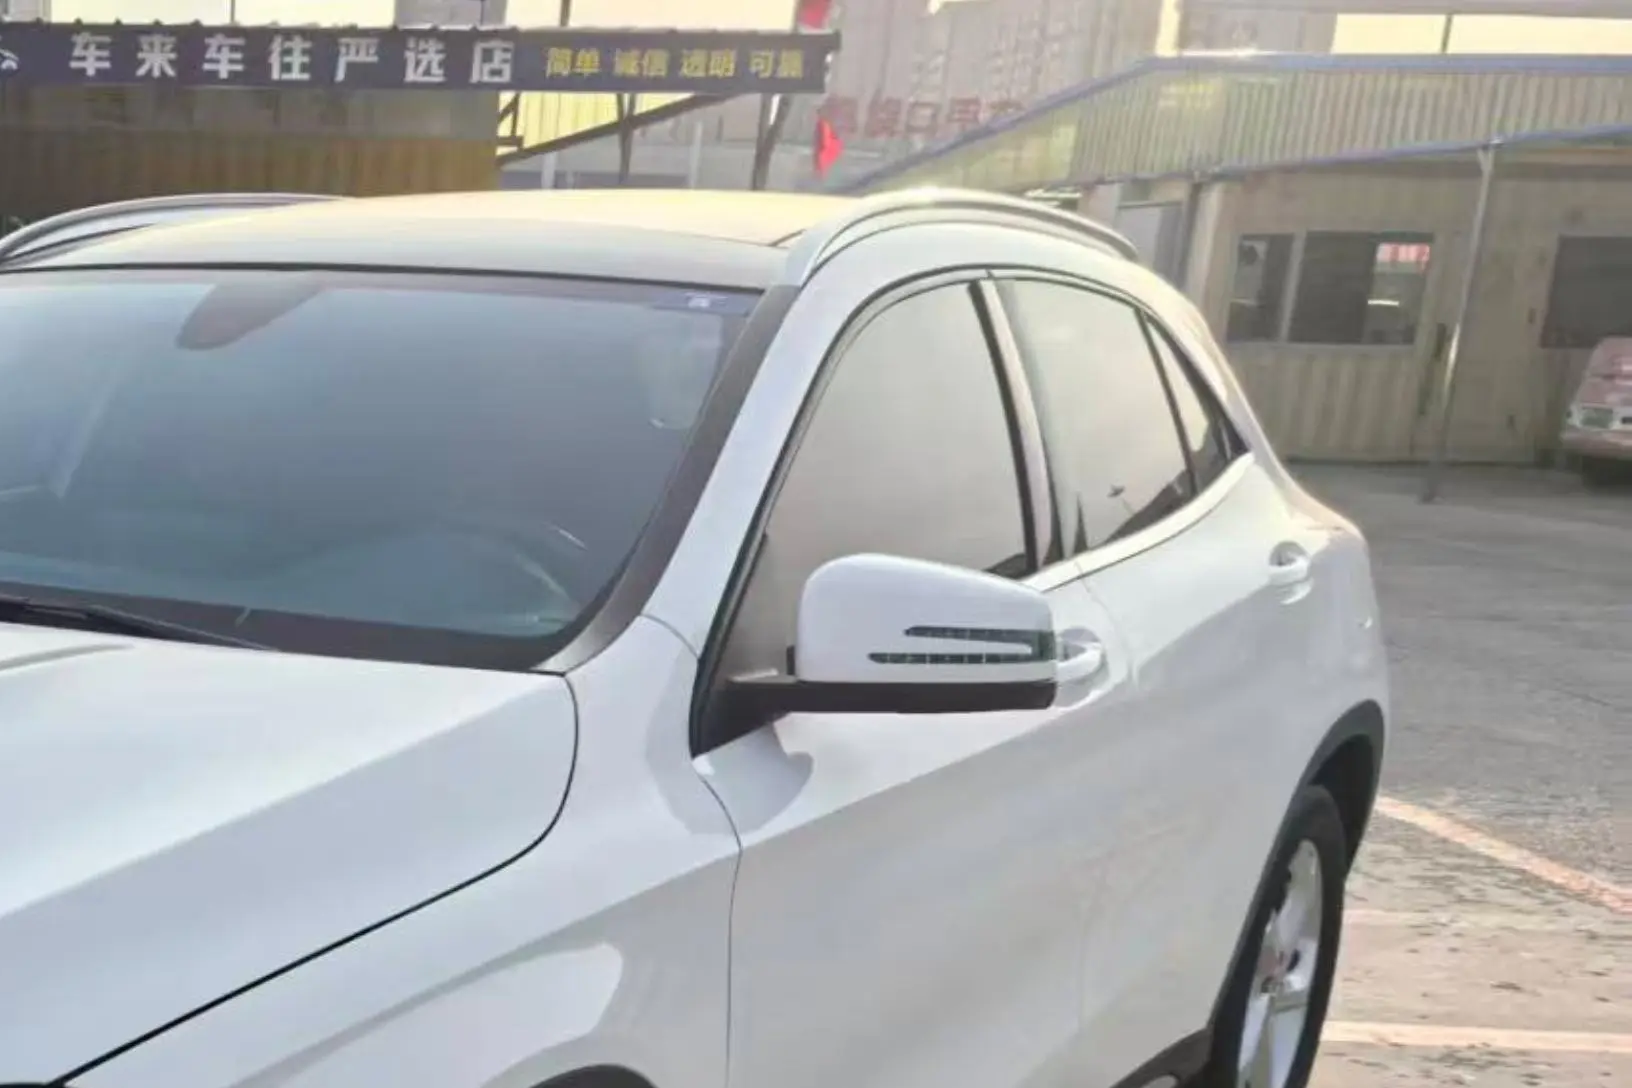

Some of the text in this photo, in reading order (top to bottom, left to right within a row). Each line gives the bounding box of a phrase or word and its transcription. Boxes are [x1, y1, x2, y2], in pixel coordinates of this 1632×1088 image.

[69, 32, 514, 83] 车来车往严选店
